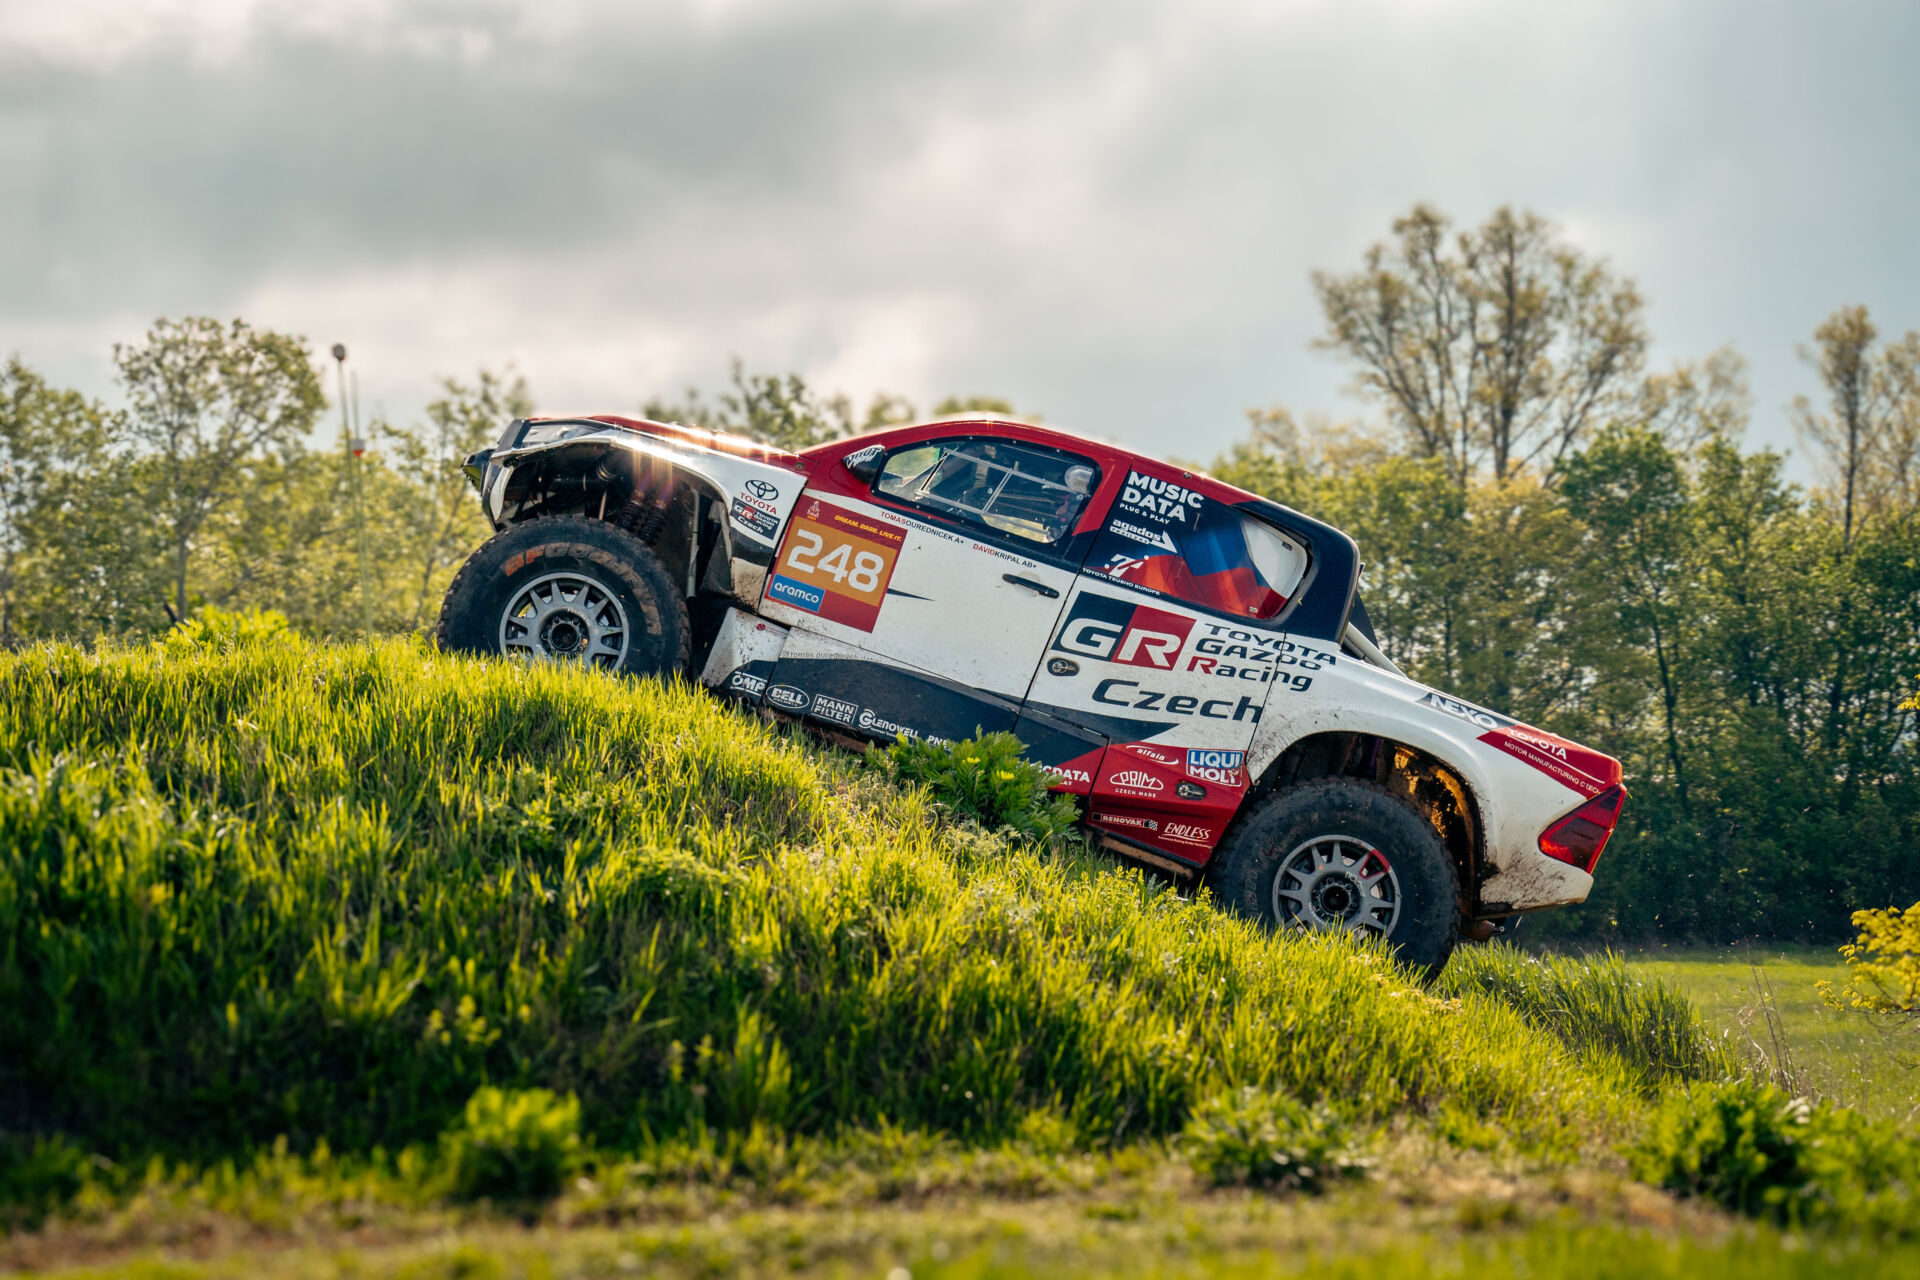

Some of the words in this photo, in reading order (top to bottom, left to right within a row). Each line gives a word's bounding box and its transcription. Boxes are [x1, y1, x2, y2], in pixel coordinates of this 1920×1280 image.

[1127, 470, 1205, 509] MUSIC
[740, 491, 777, 515] TOYOTA
[1119, 502, 1140, 514] PLUG
[1149, 514, 1170, 525] PLAY
[1121, 486, 1186, 523] DATA
[737, 515, 764, 533] Czech
[859, 523, 879, 535] DARE.
[879, 530, 894, 539] LIVE
[1112, 518, 1162, 541] agados
[786, 528, 885, 593] 248
[773, 581, 820, 604] aramco
[1082, 567, 1107, 579] TOYOTA
[1134, 584, 1161, 596] EUROPE
[1059, 617, 1182, 668] GR
[1195, 637, 1322, 671] GAZOO
[1205, 623, 1337, 666] TOYOTA
[731, 674, 766, 693] OMP
[1186, 656, 1313, 692] Racing
[770, 687, 804, 705] BELL
[817, 697, 855, 715] MANN
[1091, 678, 1266, 724] Czech
[813, 705, 852, 723] FILTER
[1430, 693, 1498, 729] NEXO
[1507, 727, 1568, 760] TOYOTA
[1190, 751, 1242, 768] LIQUI
[1504, 741, 1528, 757] MOTOR
[1528, 753, 1580, 785] MANUFACTURING
[1119, 770, 1157, 789] PRIM
[1189, 765, 1240, 784] MOLY
[1102, 815, 1143, 826] RENOVAK
[1164, 822, 1212, 840] ENDLESS
